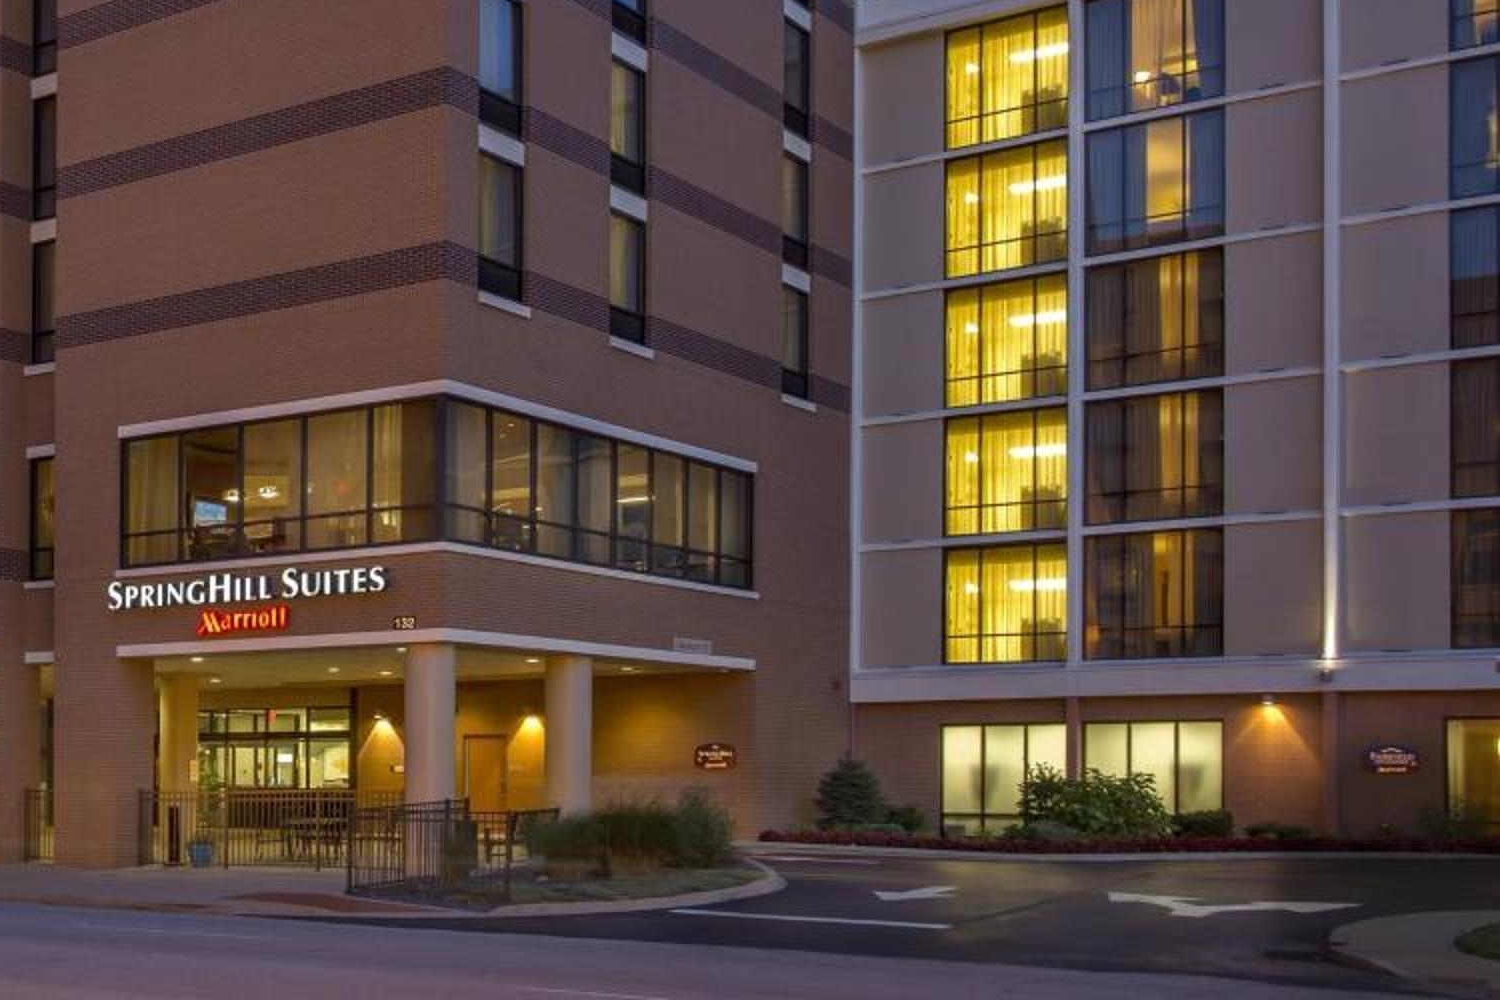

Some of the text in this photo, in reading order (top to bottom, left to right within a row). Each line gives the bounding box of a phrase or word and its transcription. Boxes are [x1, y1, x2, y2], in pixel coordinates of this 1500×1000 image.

[107, 566, 386, 610] SPRINGHILL SUITES
[197, 606, 290, 637] Marriott
